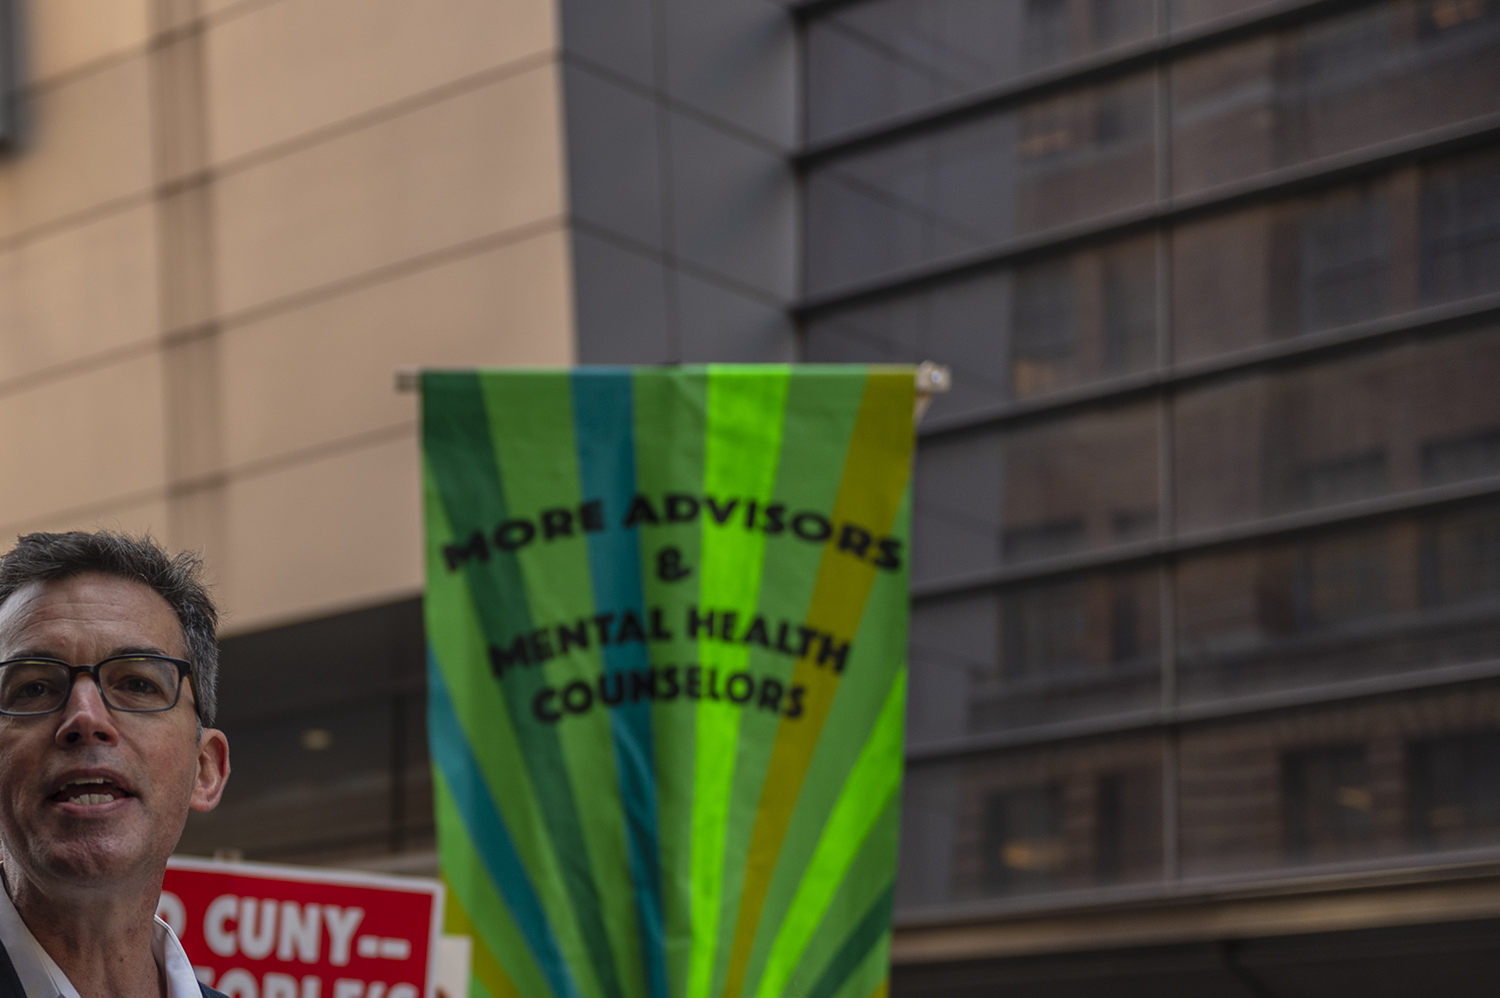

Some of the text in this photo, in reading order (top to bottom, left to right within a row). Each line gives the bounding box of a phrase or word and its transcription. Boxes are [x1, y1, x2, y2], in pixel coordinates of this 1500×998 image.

[442, 493, 905, 574] MORE ADVISORS
[656, 545, 692, 582] &
[489, 606, 850, 678] MENTAL HEALTH
[533, 665, 810, 726] COUNSELORS
